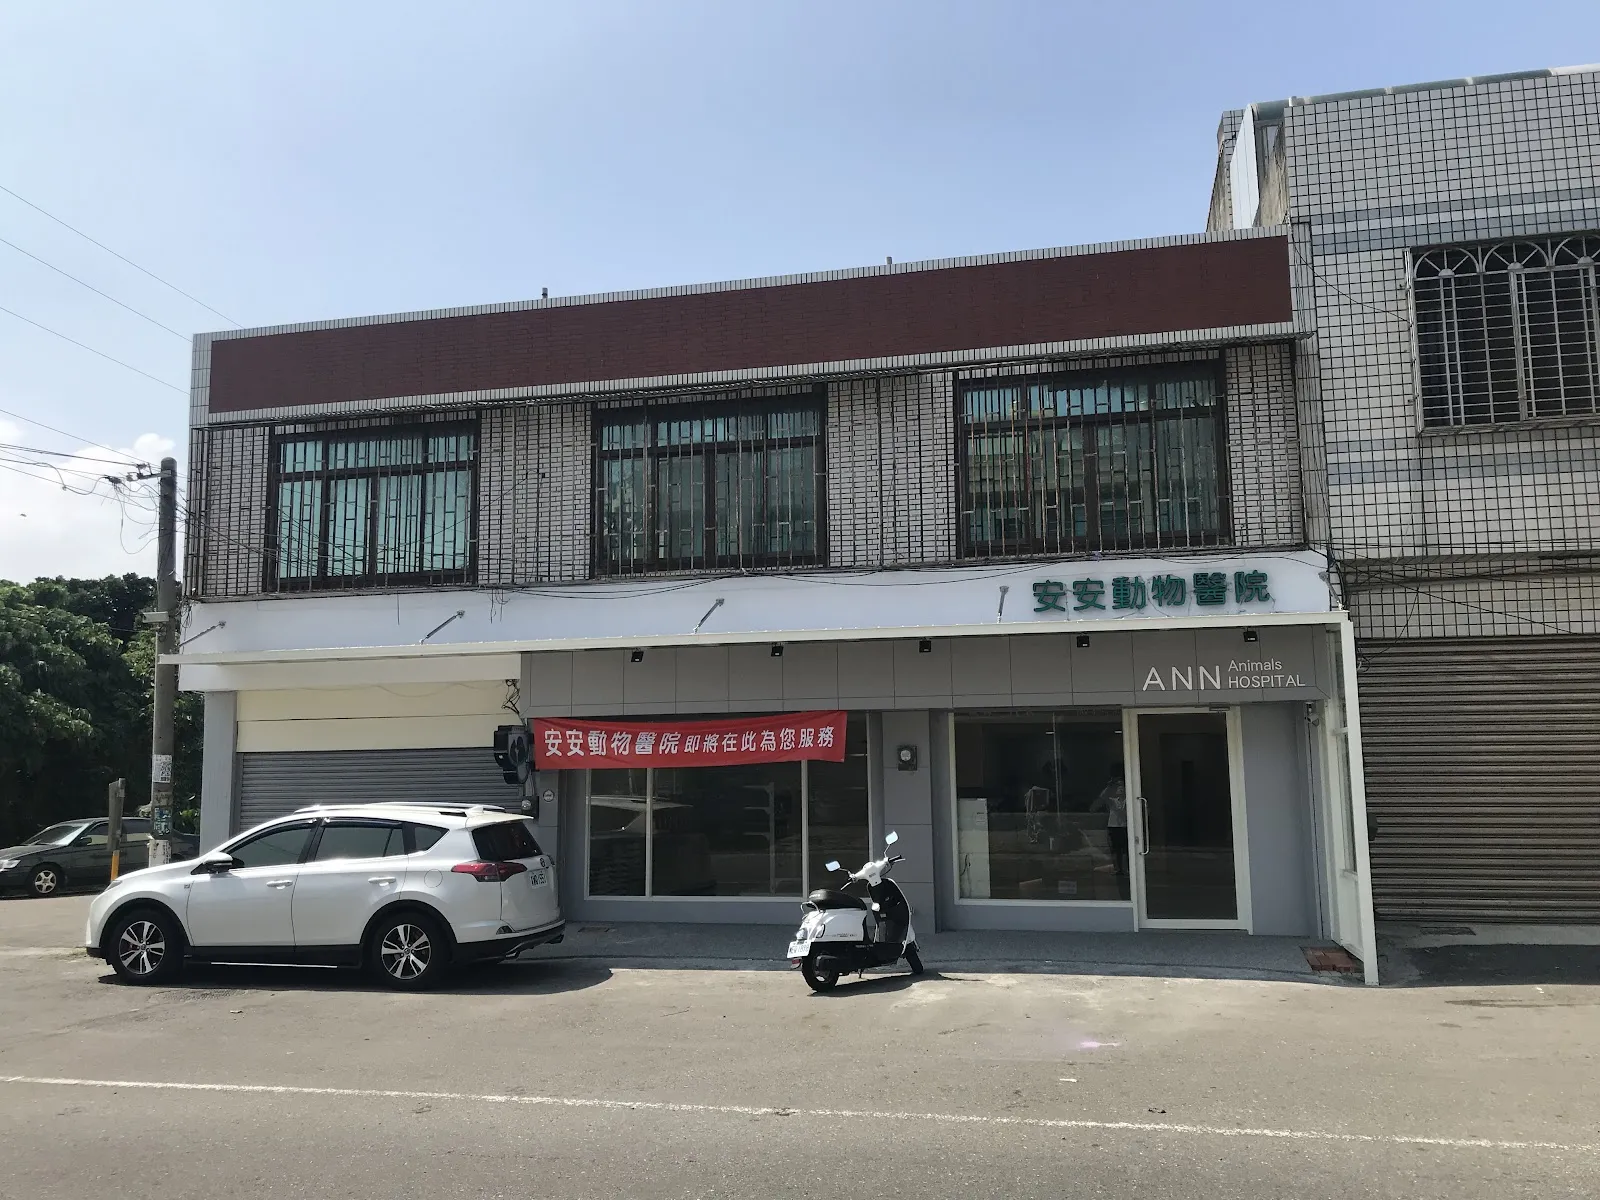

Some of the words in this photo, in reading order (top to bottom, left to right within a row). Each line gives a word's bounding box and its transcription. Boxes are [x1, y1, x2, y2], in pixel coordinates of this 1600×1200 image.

[1032, 569, 1271, 612] 安安動物醫院
[1227, 658, 1283, 672] Animals
[1142, 665, 1221, 691] ANN
[1228, 674, 1306, 689] HOSPITAL
